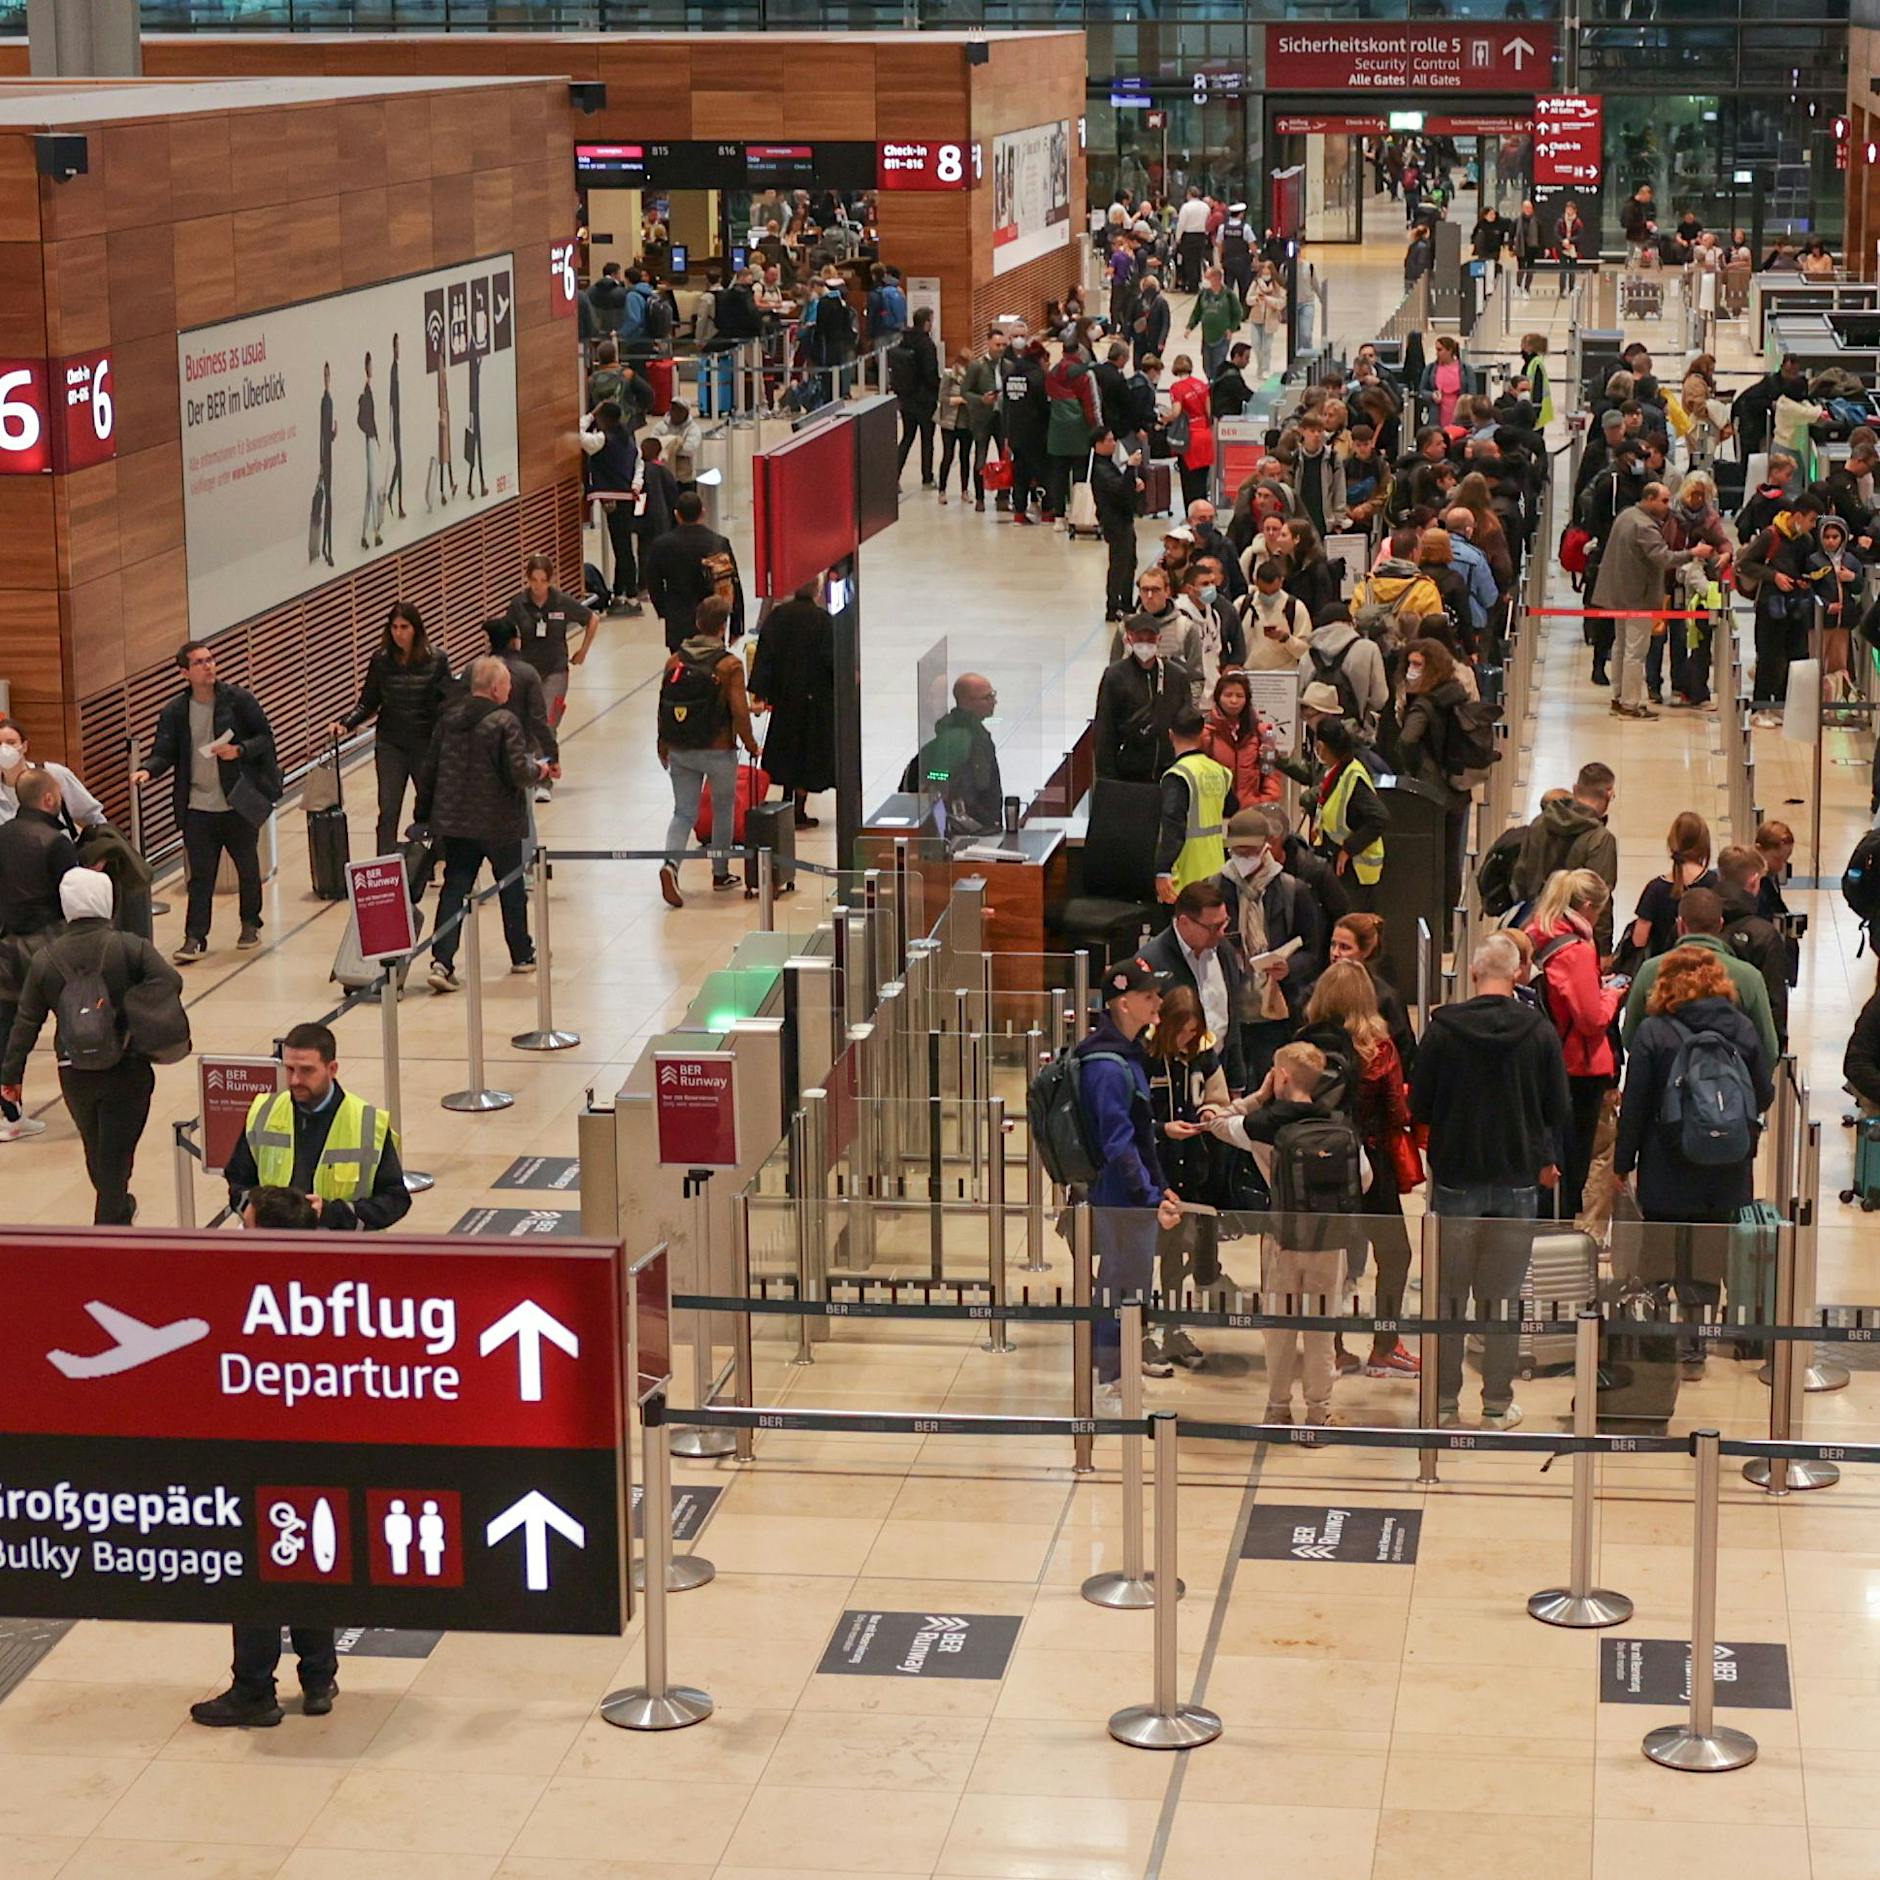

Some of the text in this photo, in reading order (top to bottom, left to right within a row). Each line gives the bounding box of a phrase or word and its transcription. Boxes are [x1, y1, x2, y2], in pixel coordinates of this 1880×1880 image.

[1451, 38, 1461, 53] 5
[1355, 57, 1460, 73] Security Control
[1349, 74, 1461, 86] Alle Gates All Gates
[718, 146, 736, 156] 816
[884, 144, 928, 156] Check-in
[937, 144, 963, 182] 8
[563, 243, 575, 301] 6
[185, 333, 267, 382] Business as usual
[93, 359, 113, 440] 6
[187, 371, 286, 427] Der BER im Überblick
[0, 369, 40, 451] 6
[366, 868, 382, 879] BER
[367, 875, 400, 888] Runway
[225, 1069, 247, 1080] BER
[680, 1064, 702, 1075] BER
[226, 1080, 272, 1092] Runway
[680, 1075, 728, 1090] Runway
[825, 1303, 849, 1315] BER
[969, 1306, 993, 1318] BER
[242, 1280, 457, 1355] Abflug
[1228, 1315, 1252, 1327] BER
[1373, 1320, 1398, 1332] BER
[1521, 1321, 1545, 1333] BER
[1698, 1325, 1722, 1337] BER
[1847, 1329, 1872, 1341] BER
[220, 1352, 460, 1407] Departure
[759, 1415, 784, 1428] BER
[914, 1420, 939, 1433] BER
[1071, 1421, 1096, 1434] BER
[1290, 1429, 1316, 1442] BER
[1450, 1436, 1476, 1448] BER
[1611, 1439, 1636, 1451] BER
[1819, 1447, 1845, 1460] BER
[0, 1481, 243, 1534] roßgepäck
[1317, 1508, 1352, 1545] Runway
[1292, 1526, 1317, 1544] BER
[93, 1541, 244, 1584] Baggage
[938, 1632, 967, 1653] BER
[896, 1631, 940, 1673] Runway
[1713, 1661, 1738, 1681] BER
